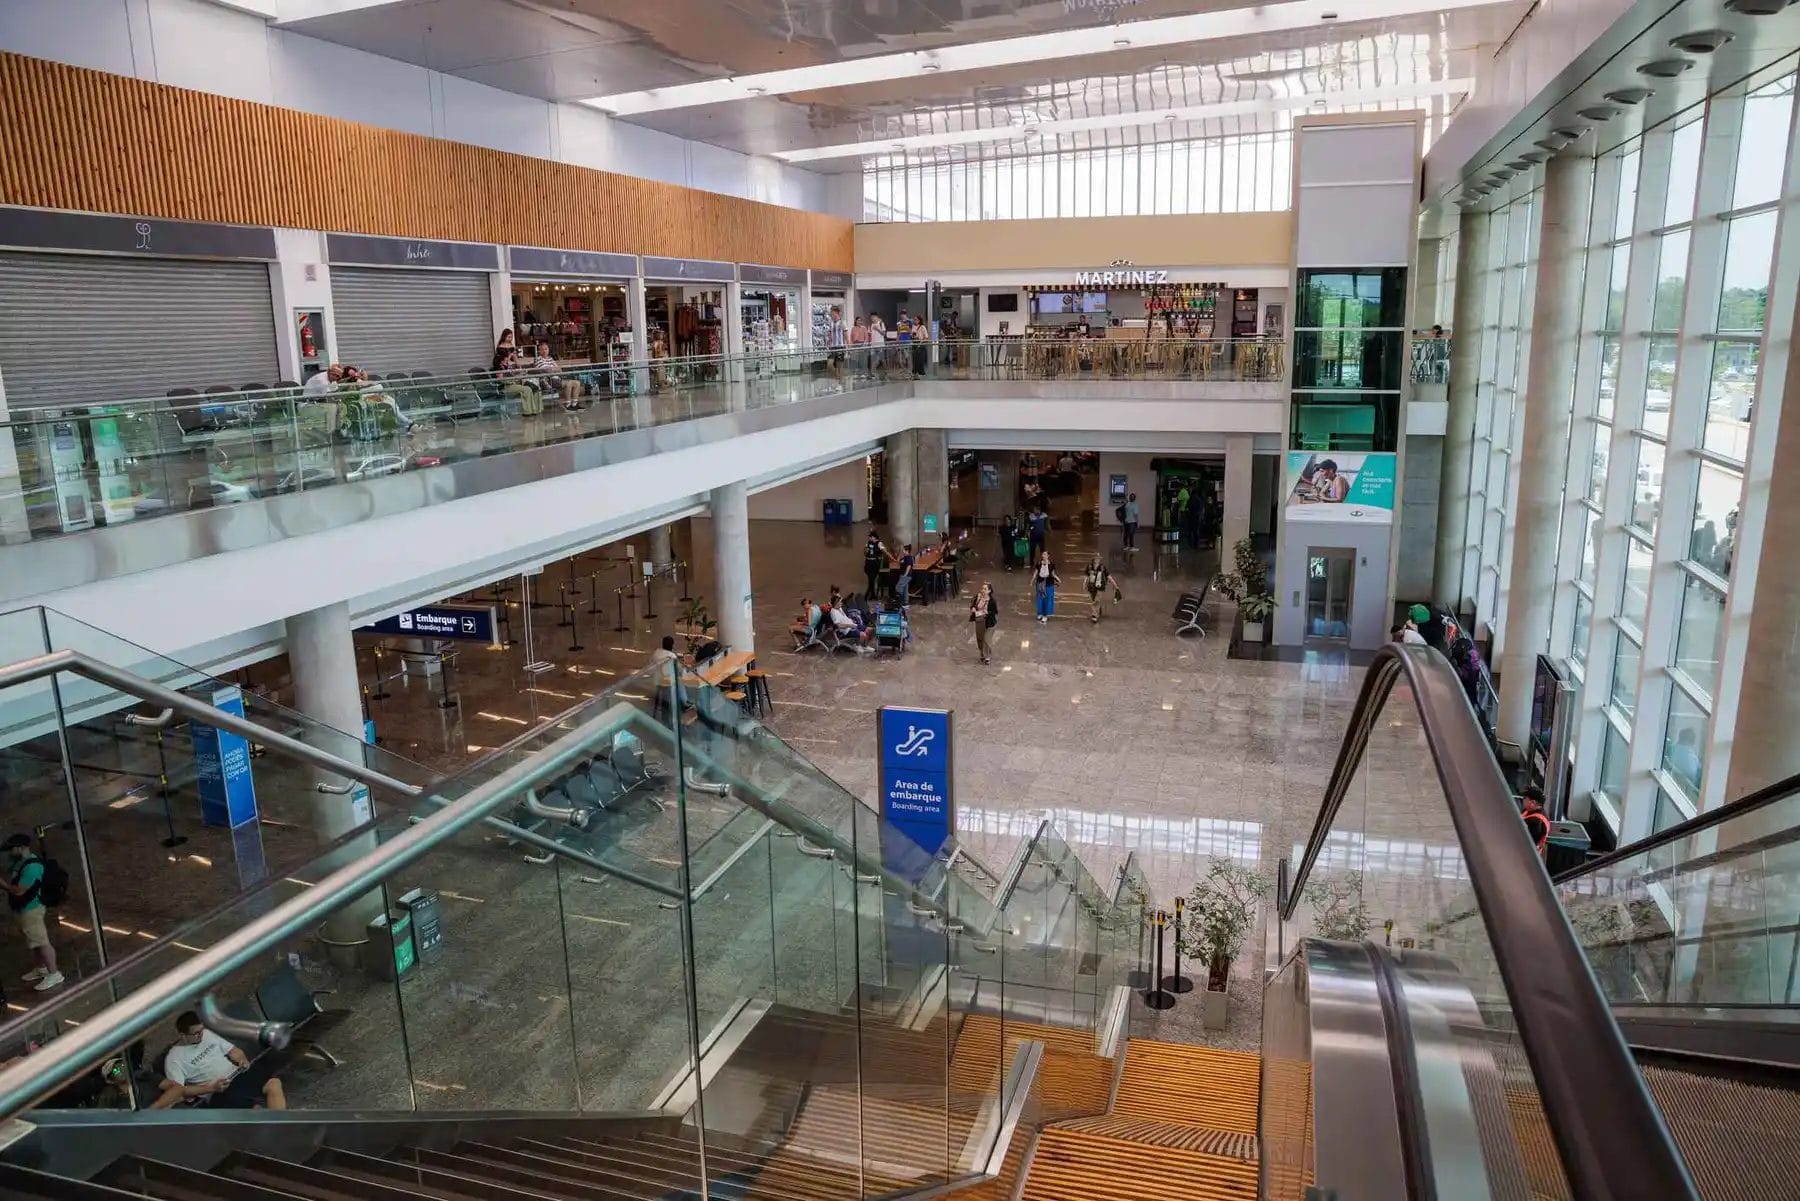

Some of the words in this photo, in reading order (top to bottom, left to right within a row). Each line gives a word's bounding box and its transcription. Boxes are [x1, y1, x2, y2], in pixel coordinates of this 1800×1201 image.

[1075, 270, 1168, 285] MARTINEZ
[416, 613, 457, 626] Embarque
[417, 623, 441, 633] Boarding
[895, 780, 919, 790] Area
[920, 781, 934, 791] de
[890, 791, 942, 803] embarque
[892, 801, 923, 812] Boarding
[924, 804, 940, 813] area
